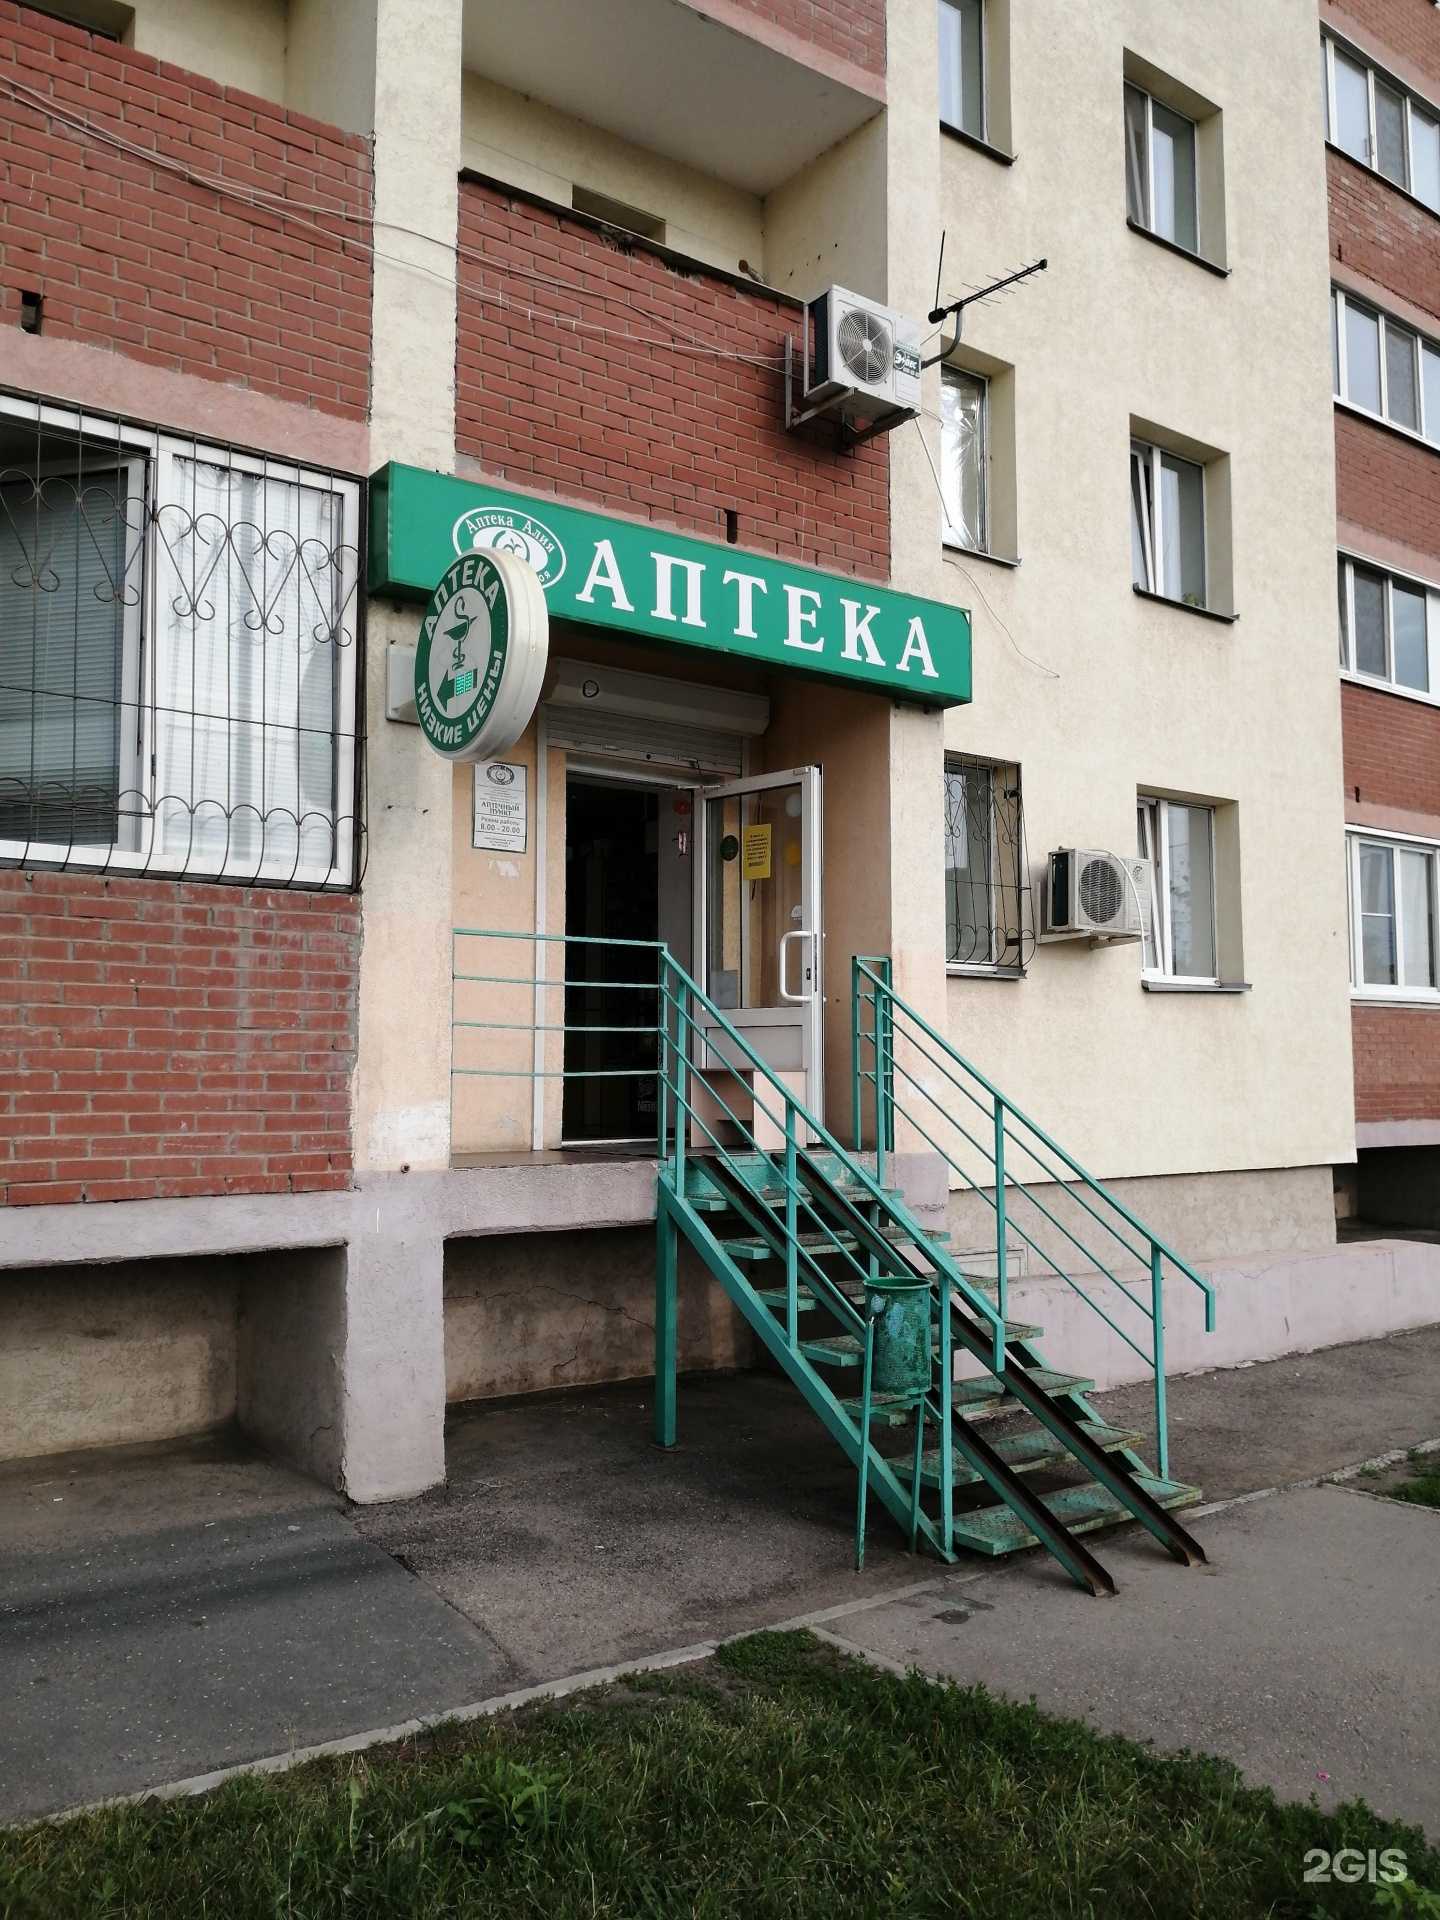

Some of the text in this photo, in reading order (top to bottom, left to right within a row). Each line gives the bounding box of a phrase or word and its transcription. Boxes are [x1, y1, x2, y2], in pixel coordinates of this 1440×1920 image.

[465, 514, 555, 553] Аптека Алия
[424, 559, 500, 641] АПТЕКА
[575, 538, 940, 679] АПТЕКА
[416, 650, 504, 744] НИЗКИЕ ЦЕНЫ
[481, 801, 520, 811] АПТЕЧНЫЙ
[489, 807, 512, 816] ПУНКТ
[501, 825, 521, 834] 20.00
